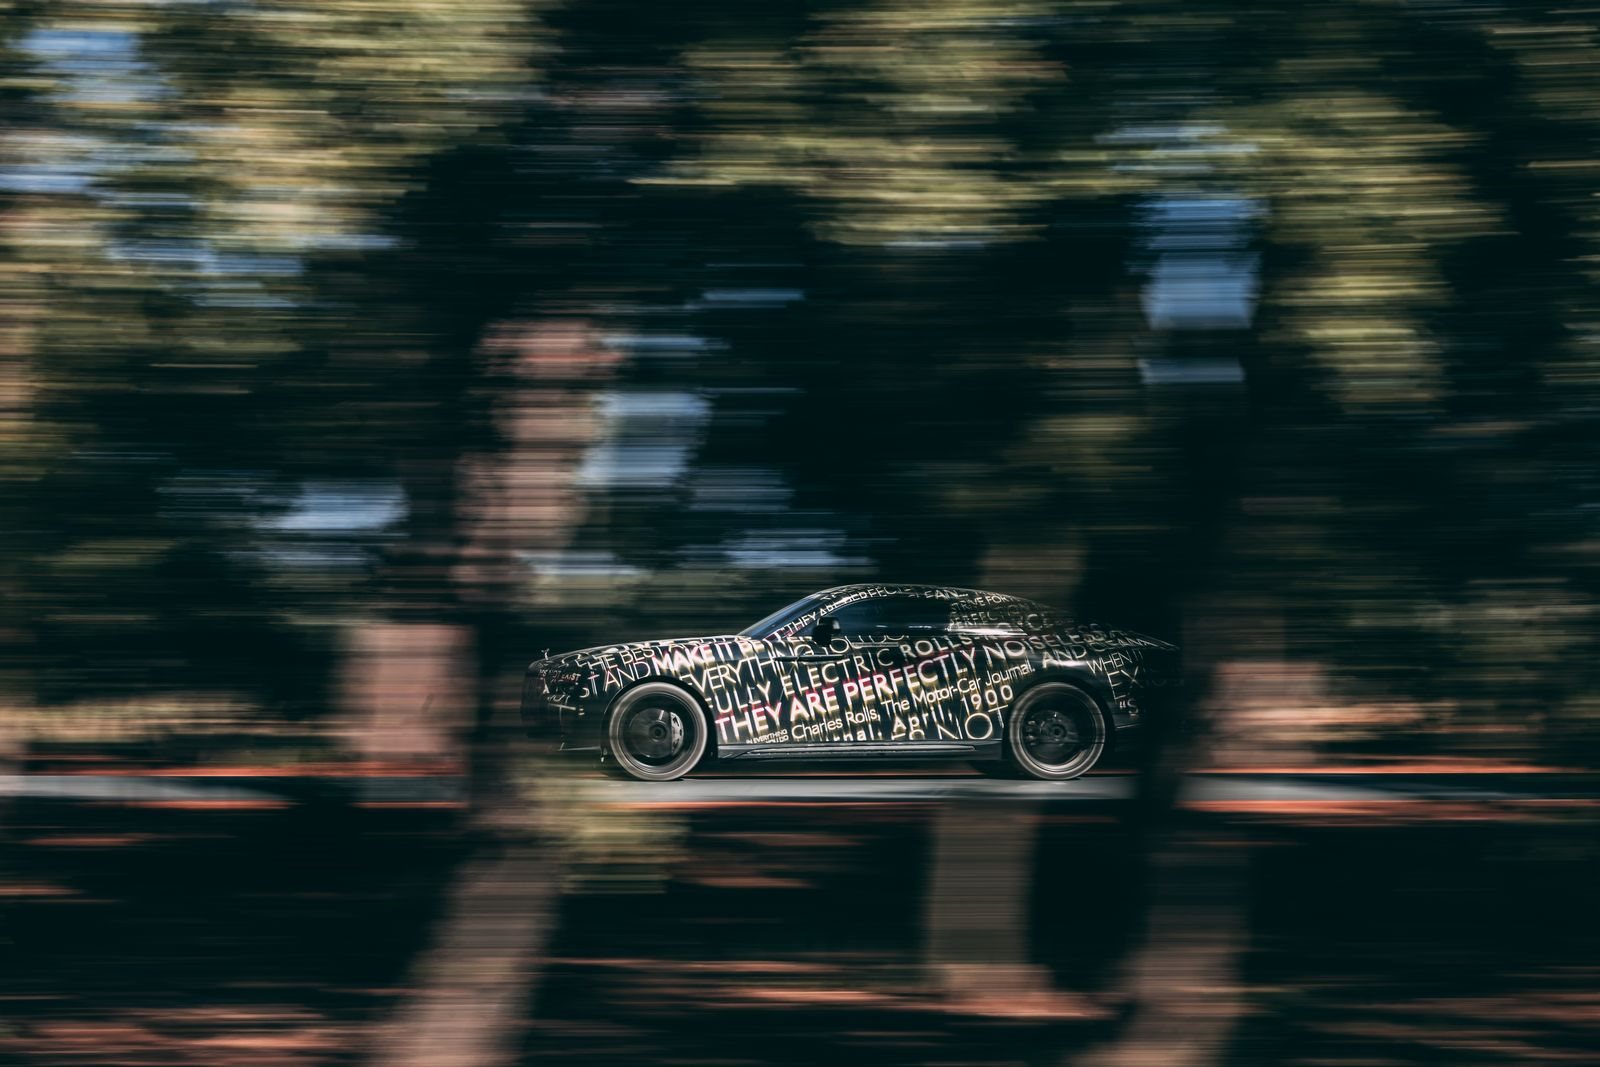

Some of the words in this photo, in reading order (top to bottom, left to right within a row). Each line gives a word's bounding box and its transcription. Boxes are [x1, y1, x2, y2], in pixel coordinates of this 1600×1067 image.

[604, 660, 651, 692] AND
[652, 643, 715, 677] MAKE
[781, 648, 894, 698] ELECTRIC
[1086, 650, 1132, 676] WHEN
[715, 703, 782, 743] THEY
[790, 688, 839, 723] ARE
[842, 647, 977, 706] PERFECTLY
[791, 717, 843, 740] Charles
[845, 705, 880, 730] Rolls,
[880, 698, 910, 721] The
[911, 676, 982, 712] Motor-Car
[984, 660, 1036, 687] Journal.
[961, 684, 1013, 718] 1900
